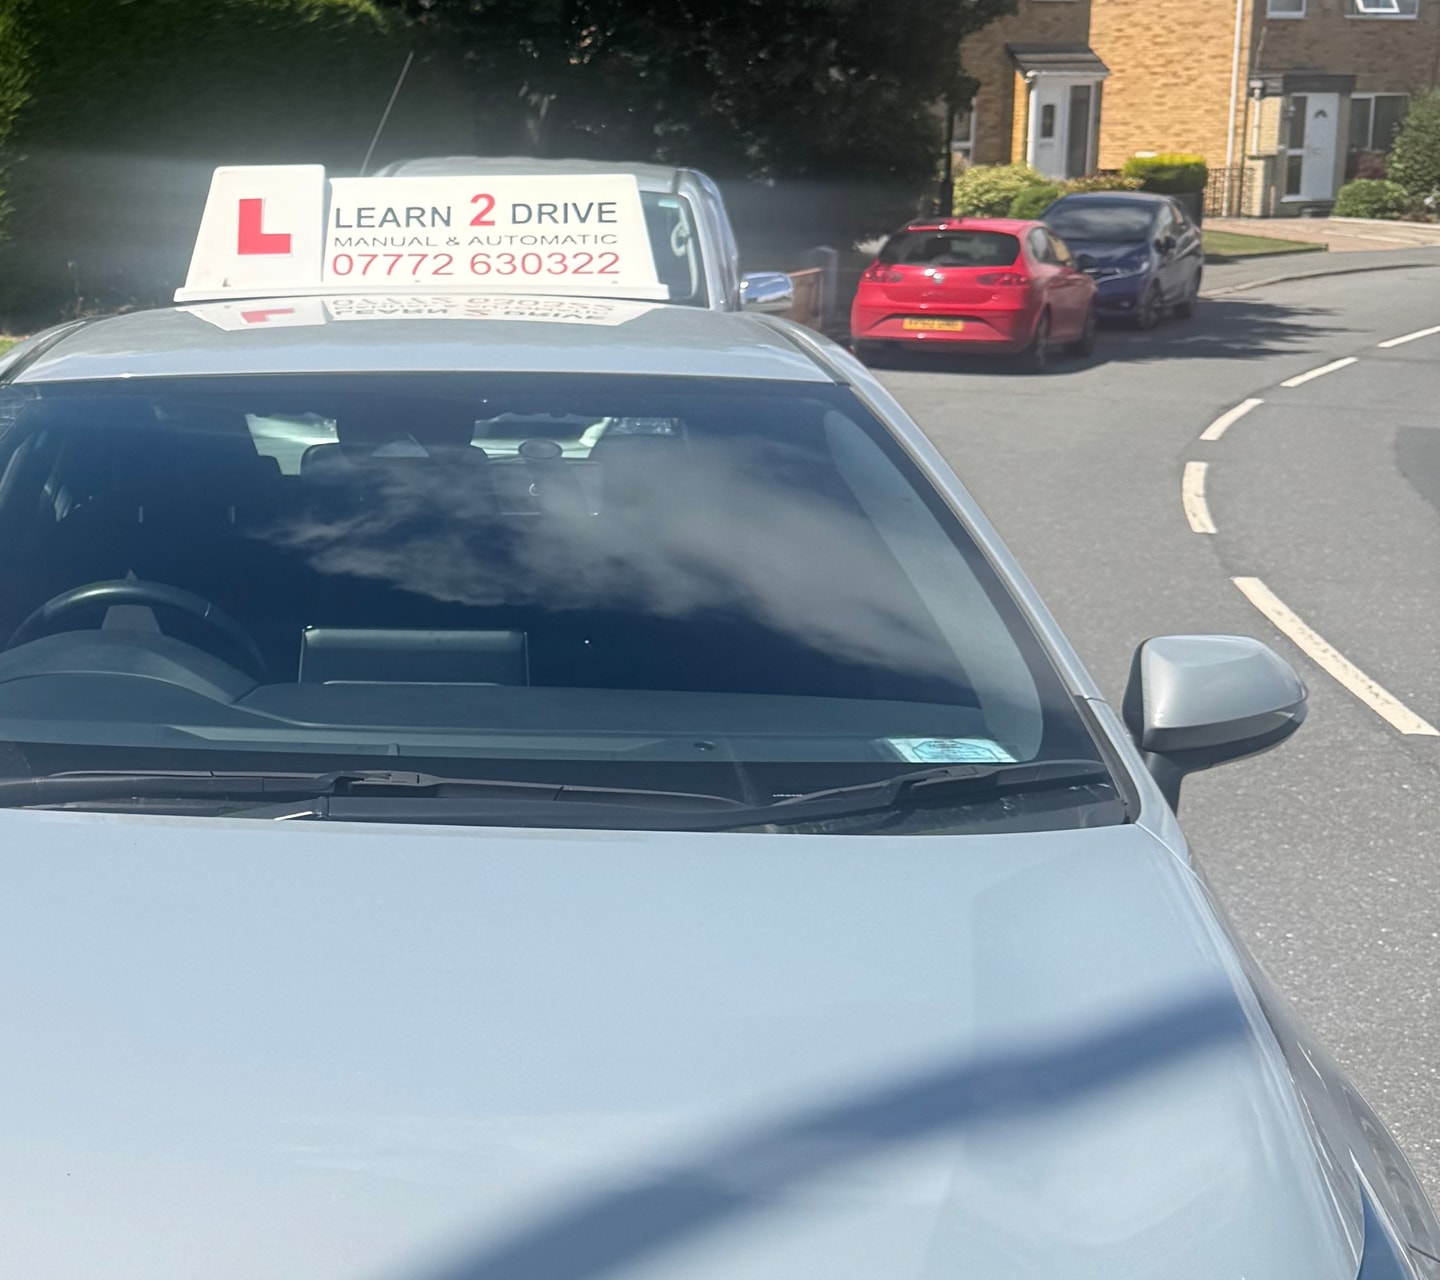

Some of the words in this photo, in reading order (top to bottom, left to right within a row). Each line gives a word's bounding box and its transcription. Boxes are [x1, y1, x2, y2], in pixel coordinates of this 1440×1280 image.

[334, 206, 452, 228] LEARN
[468, 193, 497, 227] 2
[511, 201, 618, 225] DRIVE
[237, 198, 293, 255] L
[334, 235, 439, 248] MANUAL
[445, 235, 460, 247] &
[467, 233, 618, 247] AUTOMATIC
[332, 252, 455, 276] 07772
[469, 251, 620, 276] 630322
